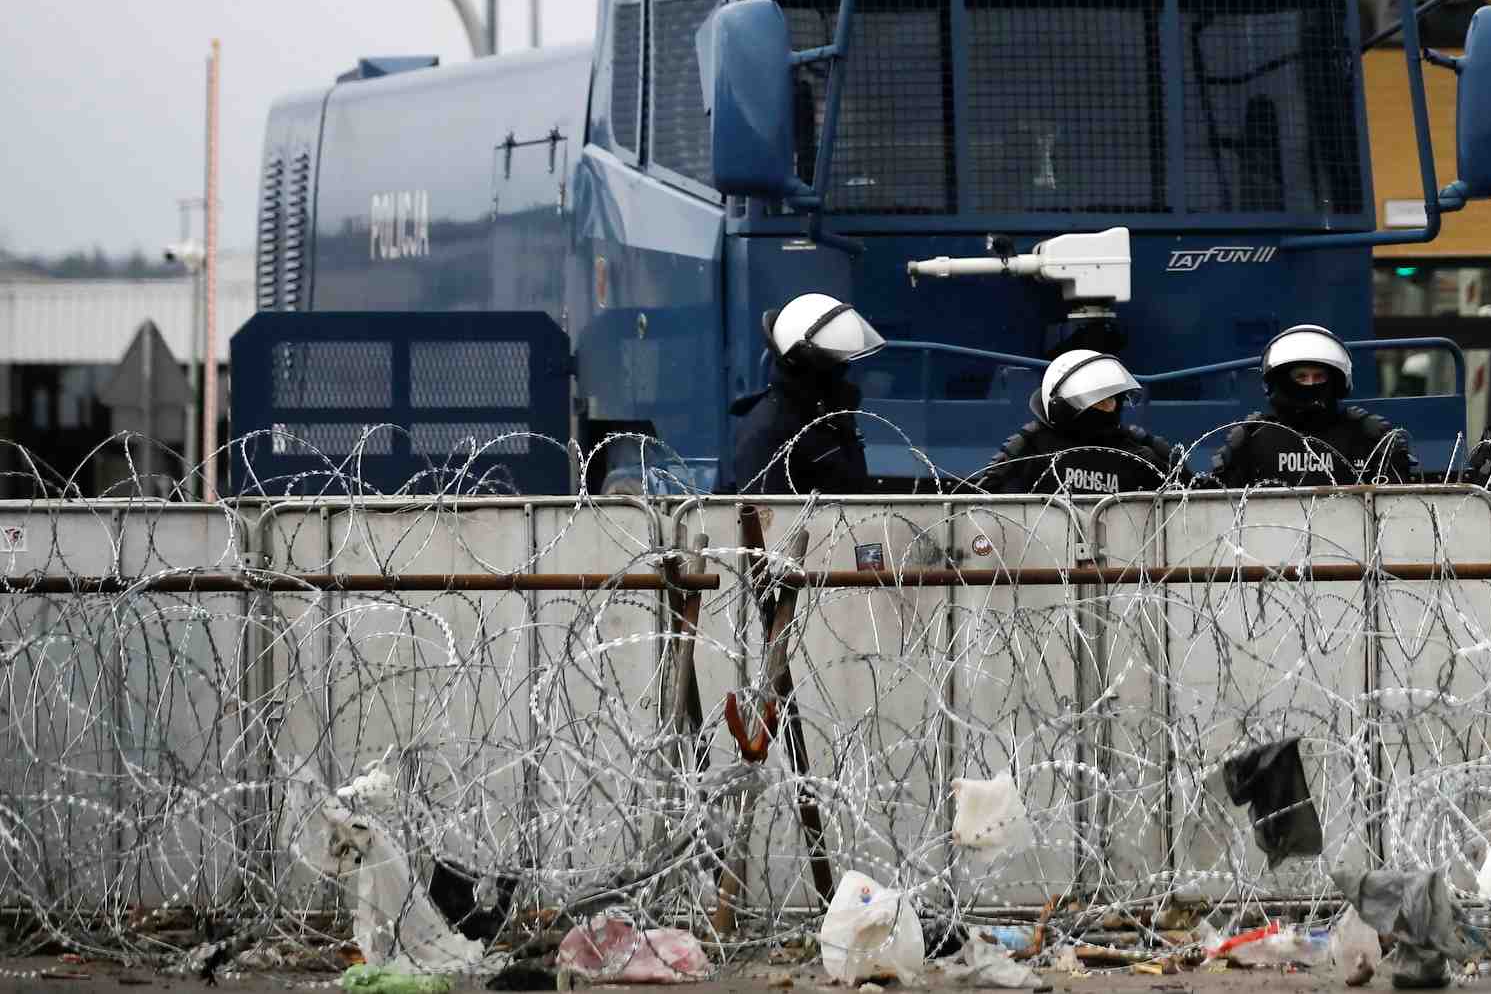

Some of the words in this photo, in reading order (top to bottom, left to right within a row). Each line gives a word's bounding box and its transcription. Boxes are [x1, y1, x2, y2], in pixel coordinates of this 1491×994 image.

[1165, 246, 1254, 271] TAJFUN
[1278, 452, 1334, 472] POLICJA
[1065, 467, 1119, 493] POLICJA
